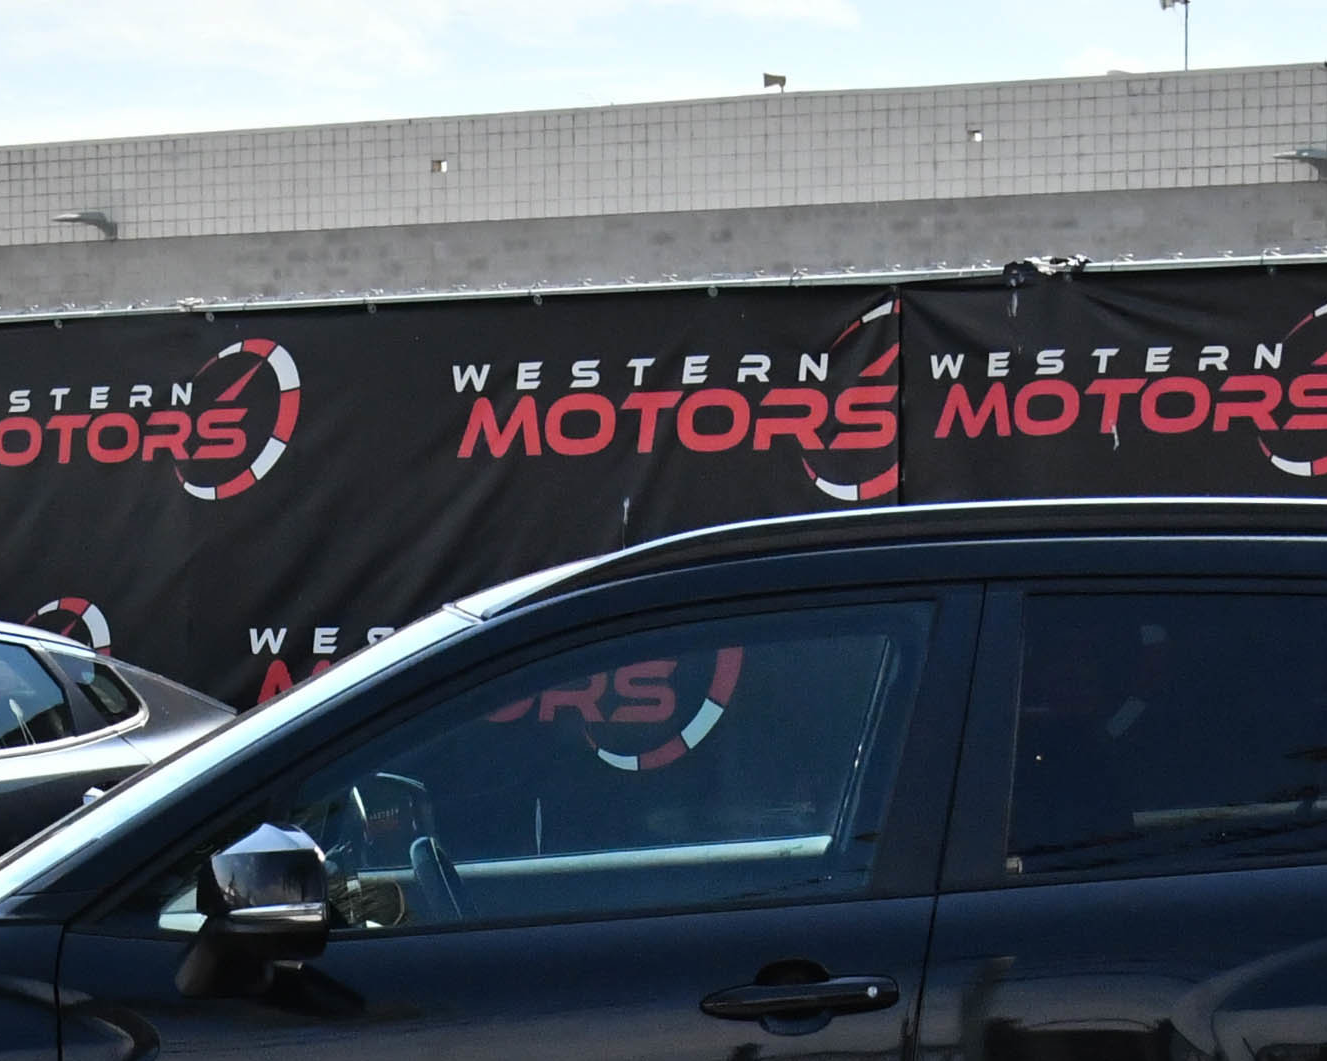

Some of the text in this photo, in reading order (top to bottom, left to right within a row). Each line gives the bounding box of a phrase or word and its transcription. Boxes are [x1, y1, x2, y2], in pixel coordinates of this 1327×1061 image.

[452, 352, 829, 393] WESTERN
[930, 342, 1283, 380] WESTERN
[457, 384, 898, 459] MOTORS
